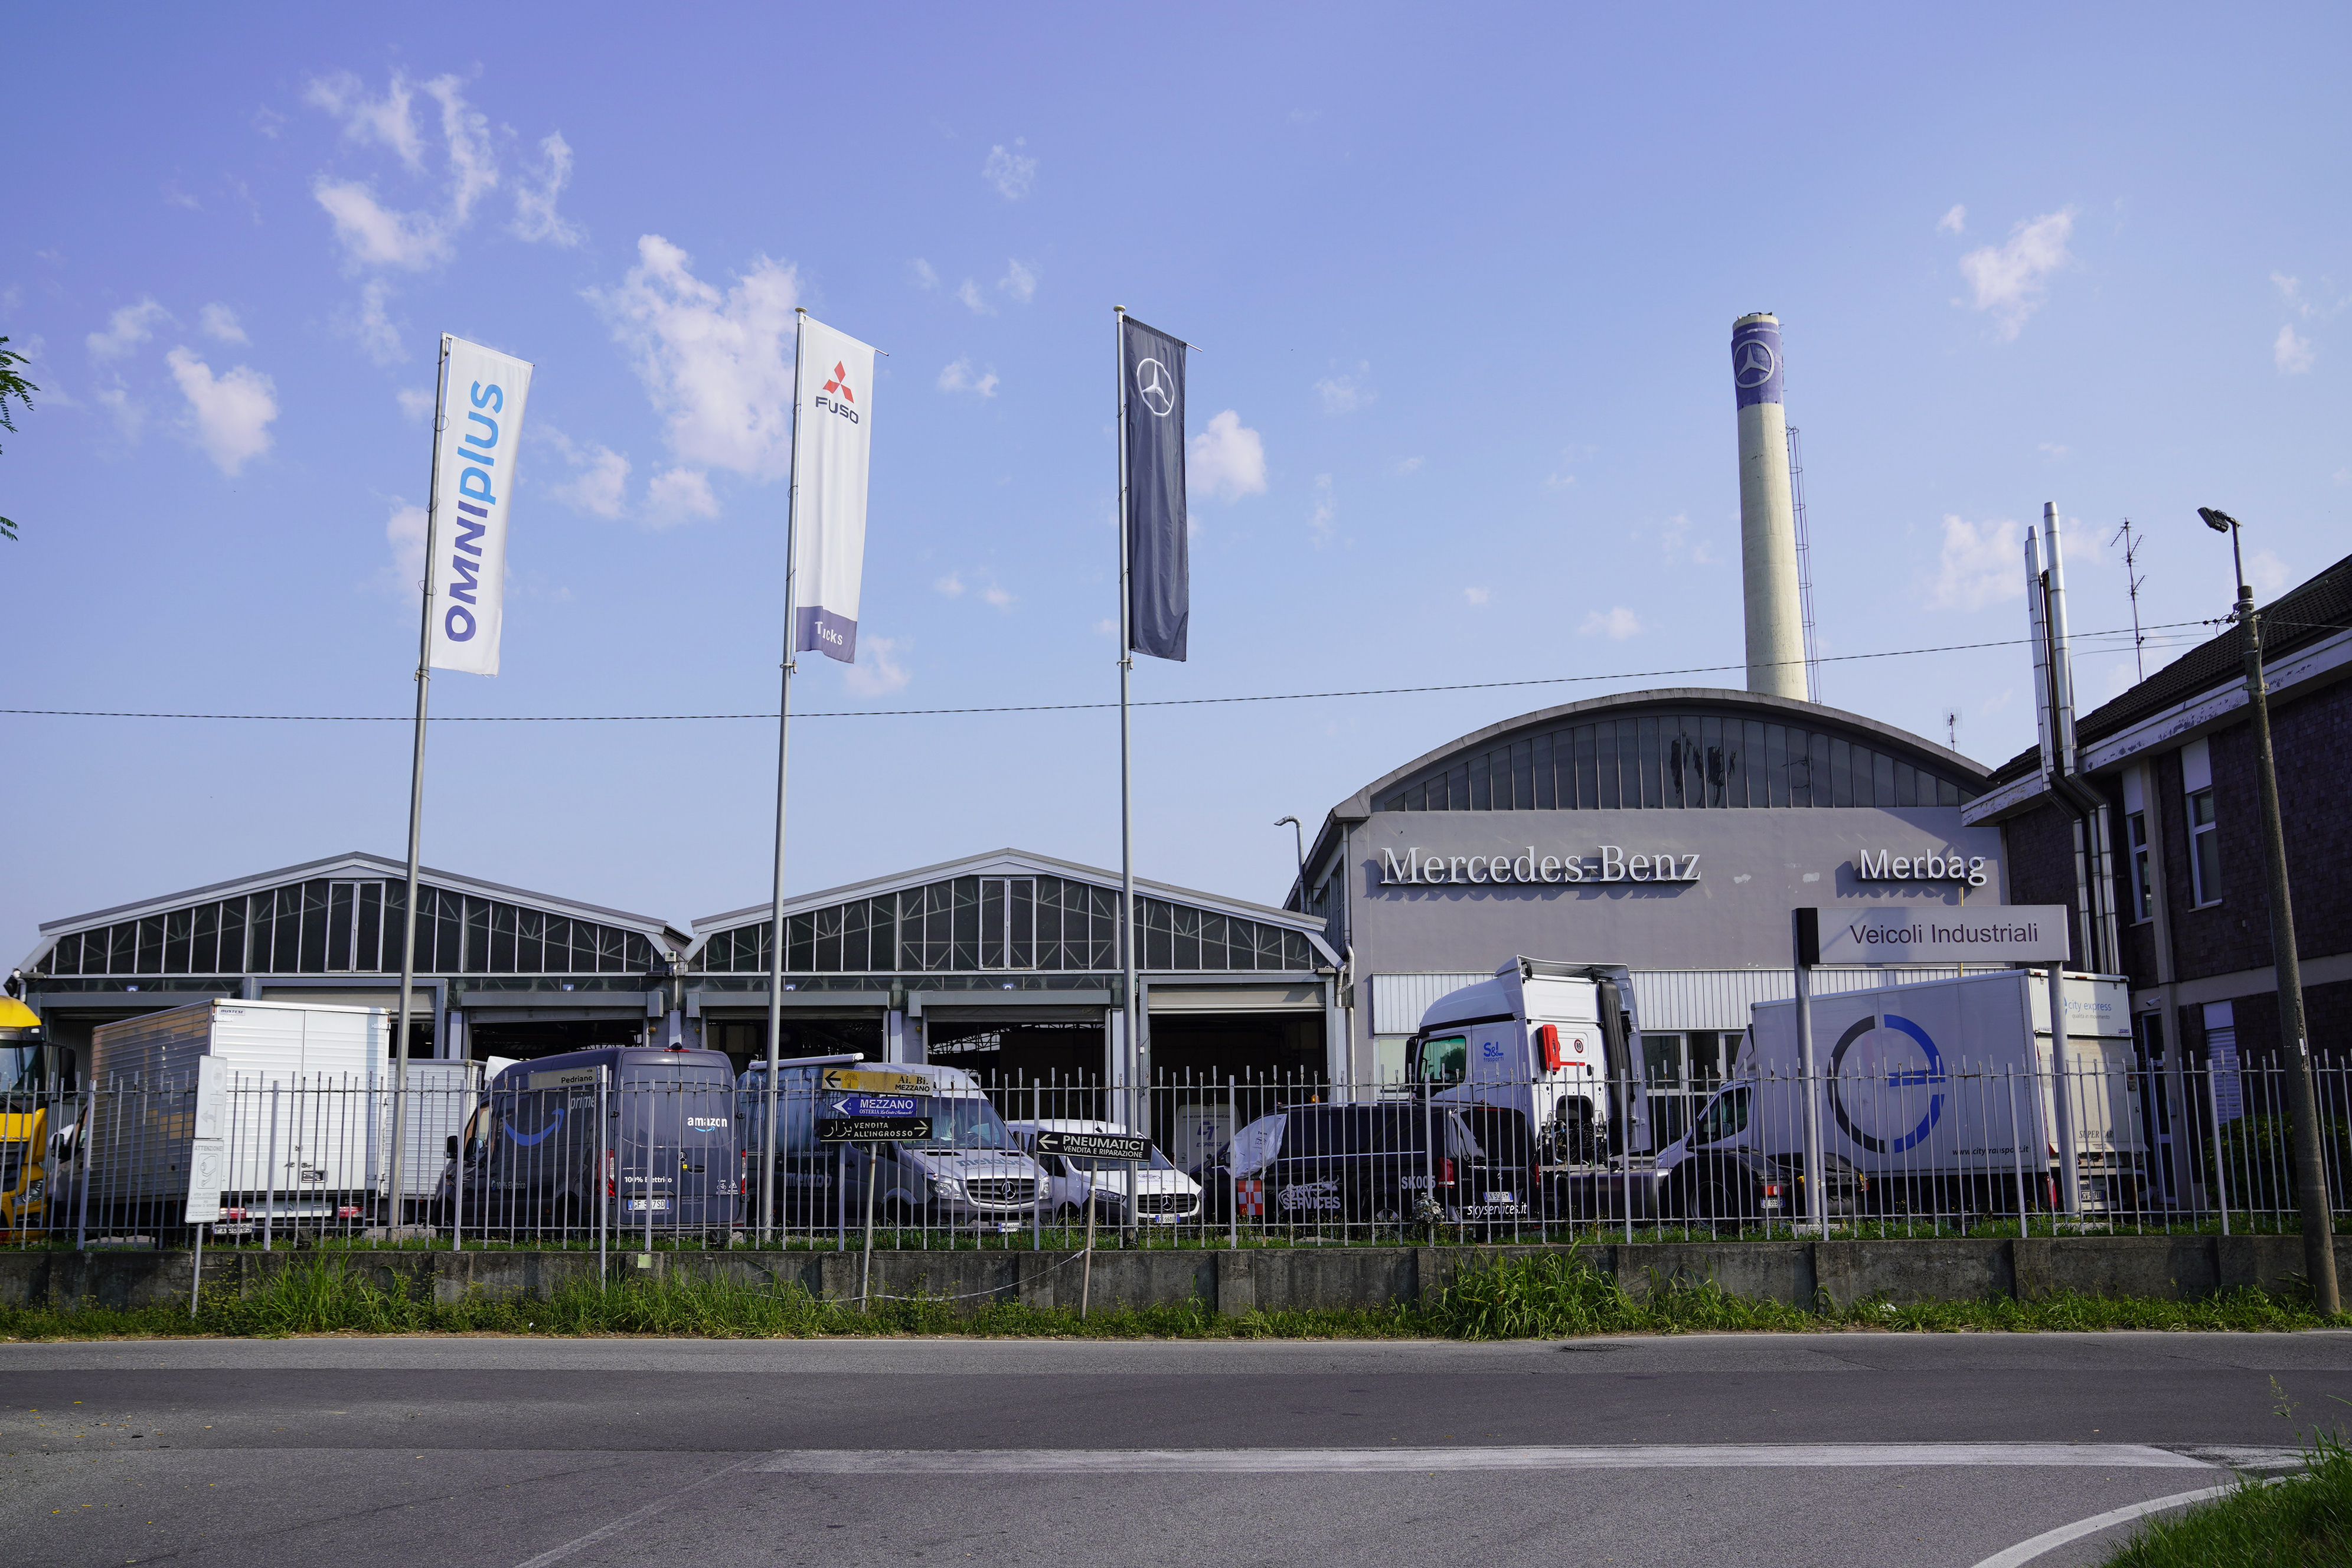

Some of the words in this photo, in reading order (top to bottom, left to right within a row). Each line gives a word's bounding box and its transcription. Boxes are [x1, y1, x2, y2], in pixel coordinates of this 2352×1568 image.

[815, 396, 859, 424] FUSO
[445, 380, 504, 642] OMNIplus
[1380, 845, 1701, 884] Mercedes-Benz
[1860, 848, 1987, 886] Merbag
[1850, 924, 1922, 944] Veicoli
[1932, 923, 2038, 943] Industriali
[2068, 999, 2082, 1012] city
[2083, 1003, 2112, 1013] express
[1483, 1041, 1504, 1057] S&L
[561, 1075, 593, 1084] Pedriano
[898, 1075, 912, 1084] Ai.
[916, 1076, 929, 1085] Bi.
[895, 1084, 930, 1092] MEZZANO
[860, 1099, 914, 1109] MEZZANO
[687, 1116, 727, 1128] amazon
[1063, 1135, 1144, 1151] PNEUMATICI
[1063, 1145, 1092, 1154] VENDITA
[1099, 1149, 1143, 1158] RIPARAZIONE
[1282, 1196, 1341, 1210] SERVICES
